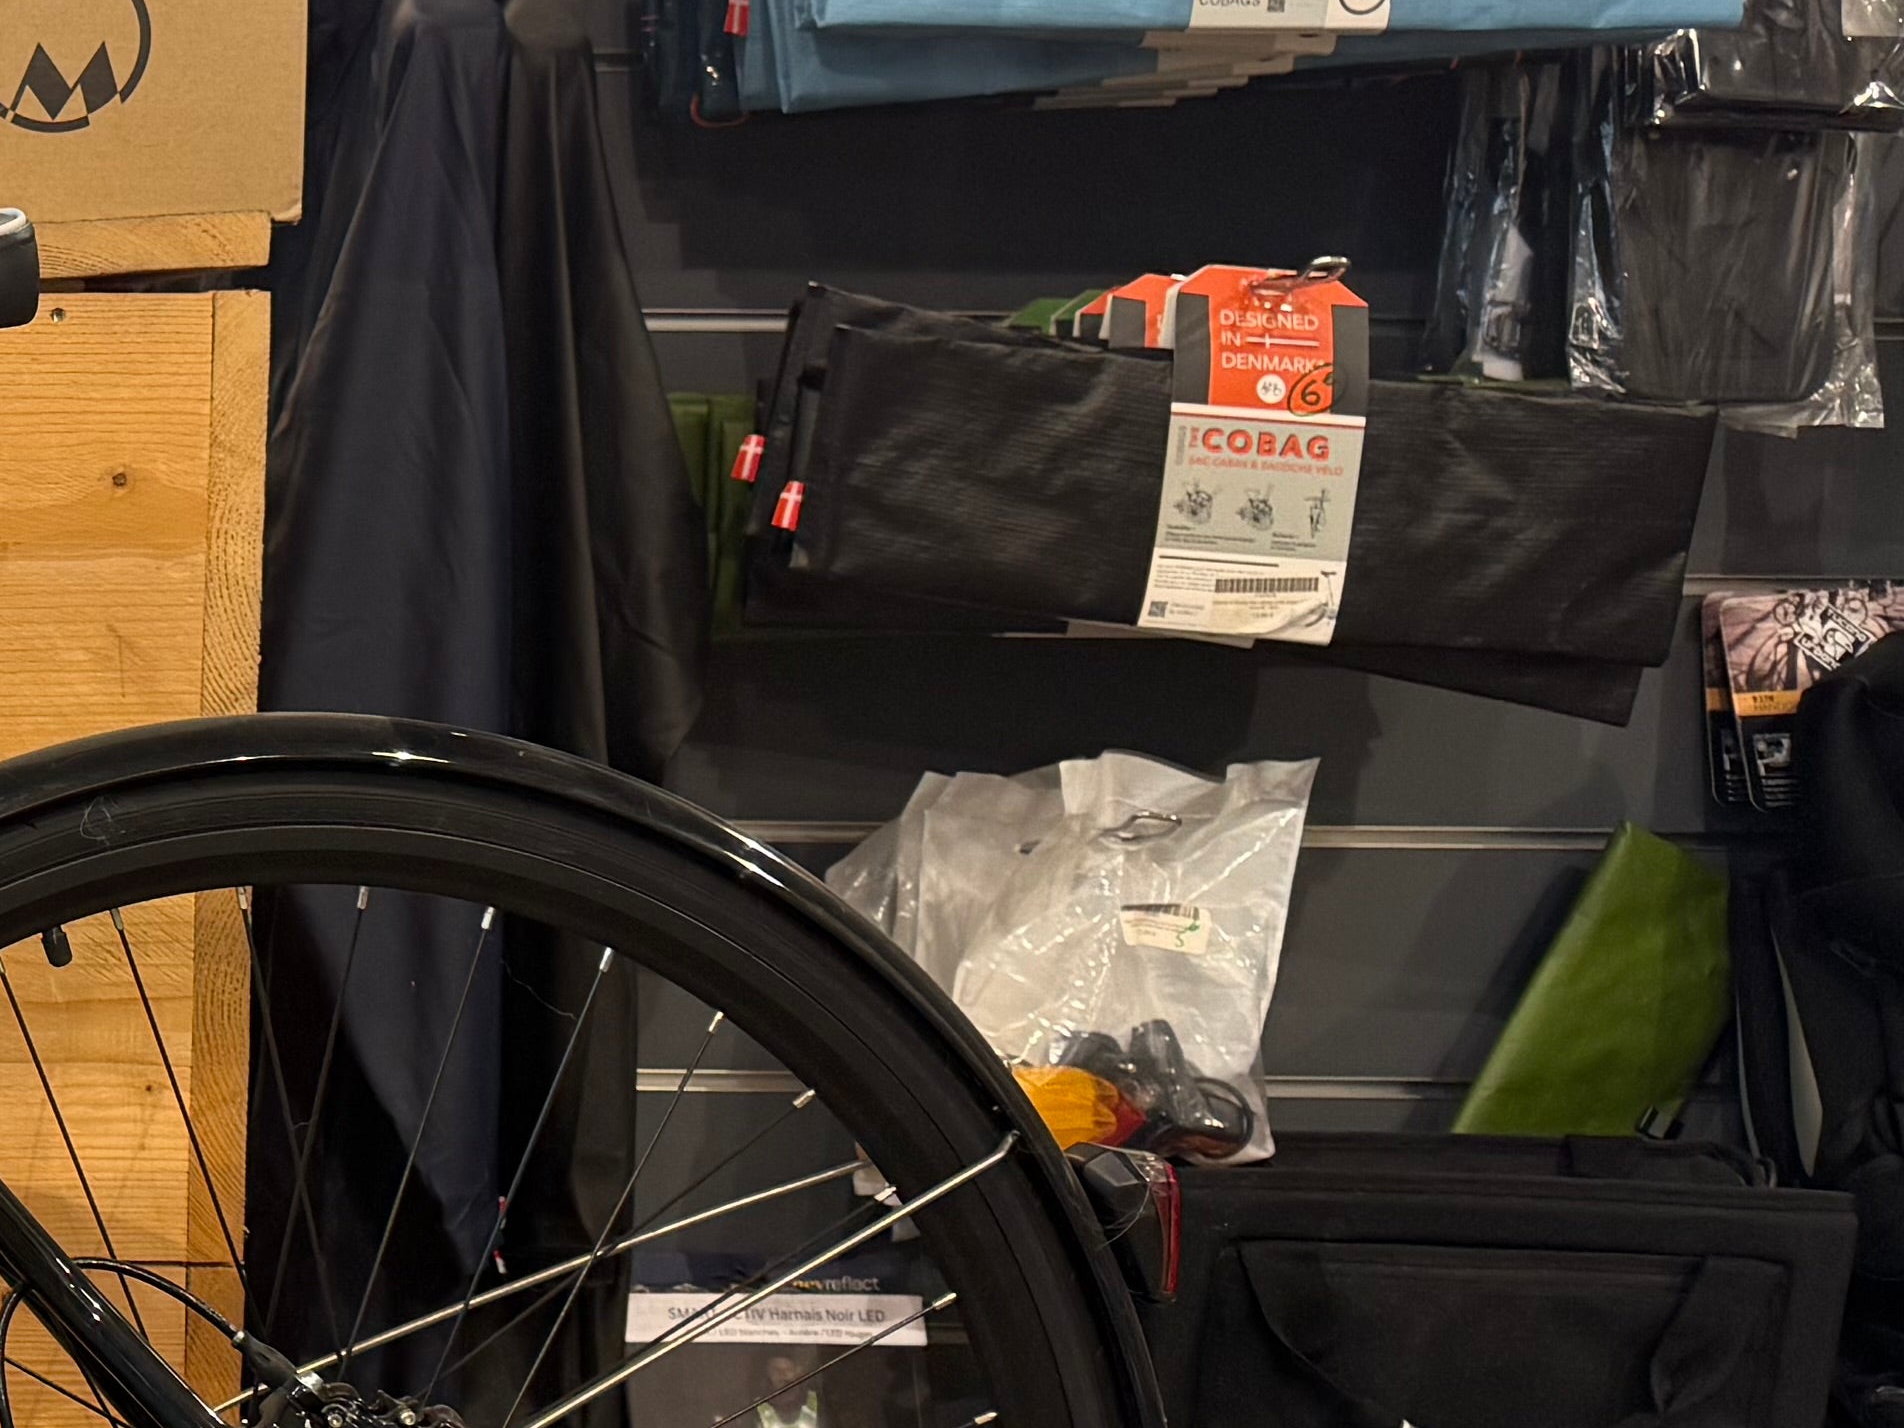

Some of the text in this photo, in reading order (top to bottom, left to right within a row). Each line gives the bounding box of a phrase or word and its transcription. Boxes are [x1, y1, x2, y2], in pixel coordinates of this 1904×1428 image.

[1220, 310, 1318, 330] DESIGNED
[1221, 331, 1240, 347] IN
[769, 1307, 822, 1321] Harnais
[826, 1309, 853, 1321] Noir
[858, 1310, 885, 1322] LED
